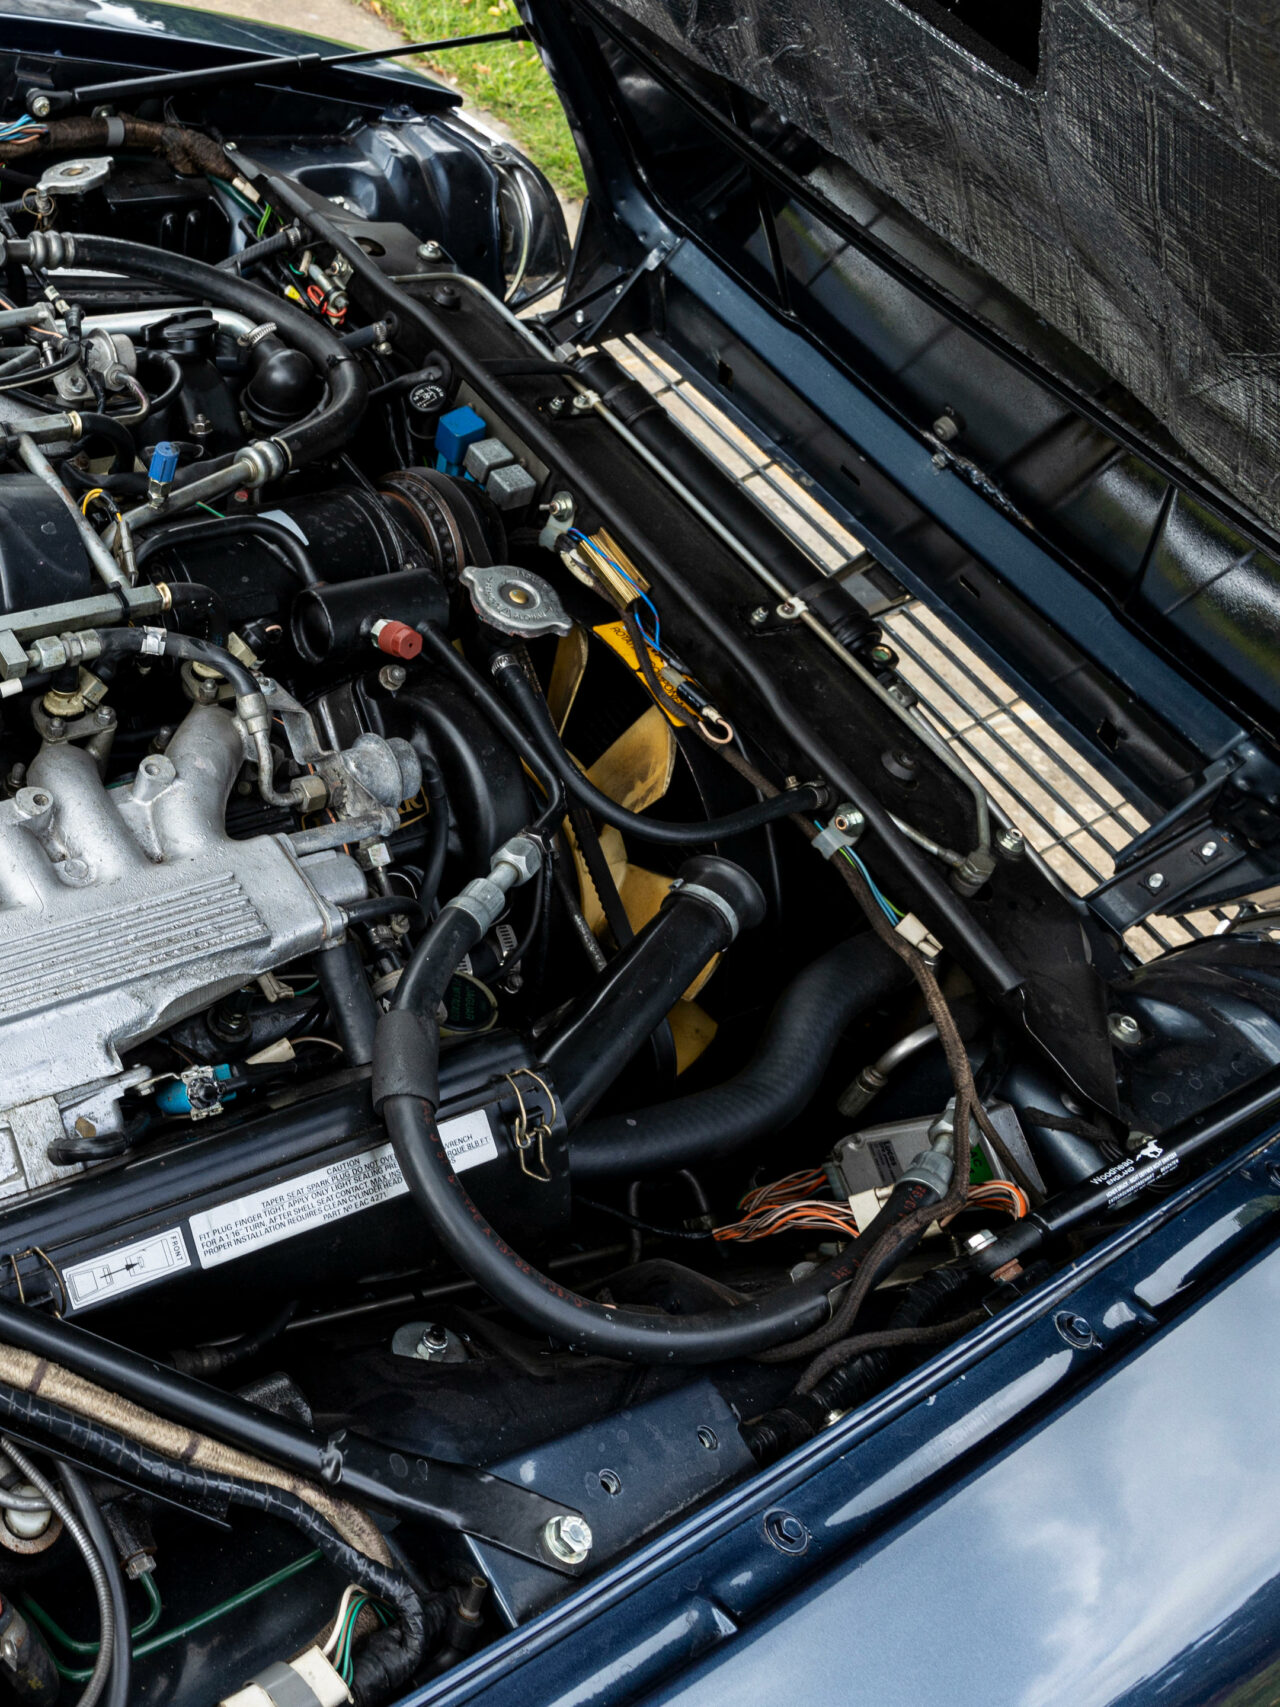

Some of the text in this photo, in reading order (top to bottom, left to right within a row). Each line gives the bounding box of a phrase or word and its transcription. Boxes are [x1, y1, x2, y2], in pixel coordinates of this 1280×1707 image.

[326, 1157, 360, 1174] CAUTION
[1089, 1156, 1134, 1187] Woodhead
[1105, 1165, 1134, 1186] ENGLAND
[200, 1237, 217, 1249] FOR
[268, 1210, 292, 1224] AFTER
[292, 1201, 314, 1214] SHELL
[316, 1194, 333, 1205] SEAT
[369, 1174, 387, 1185] MAX
[446, 1144, 466, 1157] RQUE
[260, 1195, 284, 1208] TAPER
[286, 1187, 305, 1199] SEAT
[306, 1178, 329, 1192] SPARK
[330, 1170, 350, 1182] PLUG
[351, 1166, 362, 1175] DO
[363, 1160, 378, 1170] NOT
[198, 1231, 210, 1241] FIT
[212, 1223, 232, 1236] PLUG
[234, 1213, 262, 1228] FINGER
[287, 1196, 309, 1208] APPLY
[310, 1187, 329, 1198] ONLY
[330, 1178, 352, 1191] LIGHT
[353, 1167, 383, 1183] SEALING
[203, 1176, 402, 1256] PROPER INSTALLATION REQUIRES CLEAN CYLINDER HEAD
[322, 1208, 341, 1220] PART
[354, 1198, 368, 1208] EAC
[369, 1192, 387, 1202] 4271
[170, 1235, 182, 1260] FRONT
